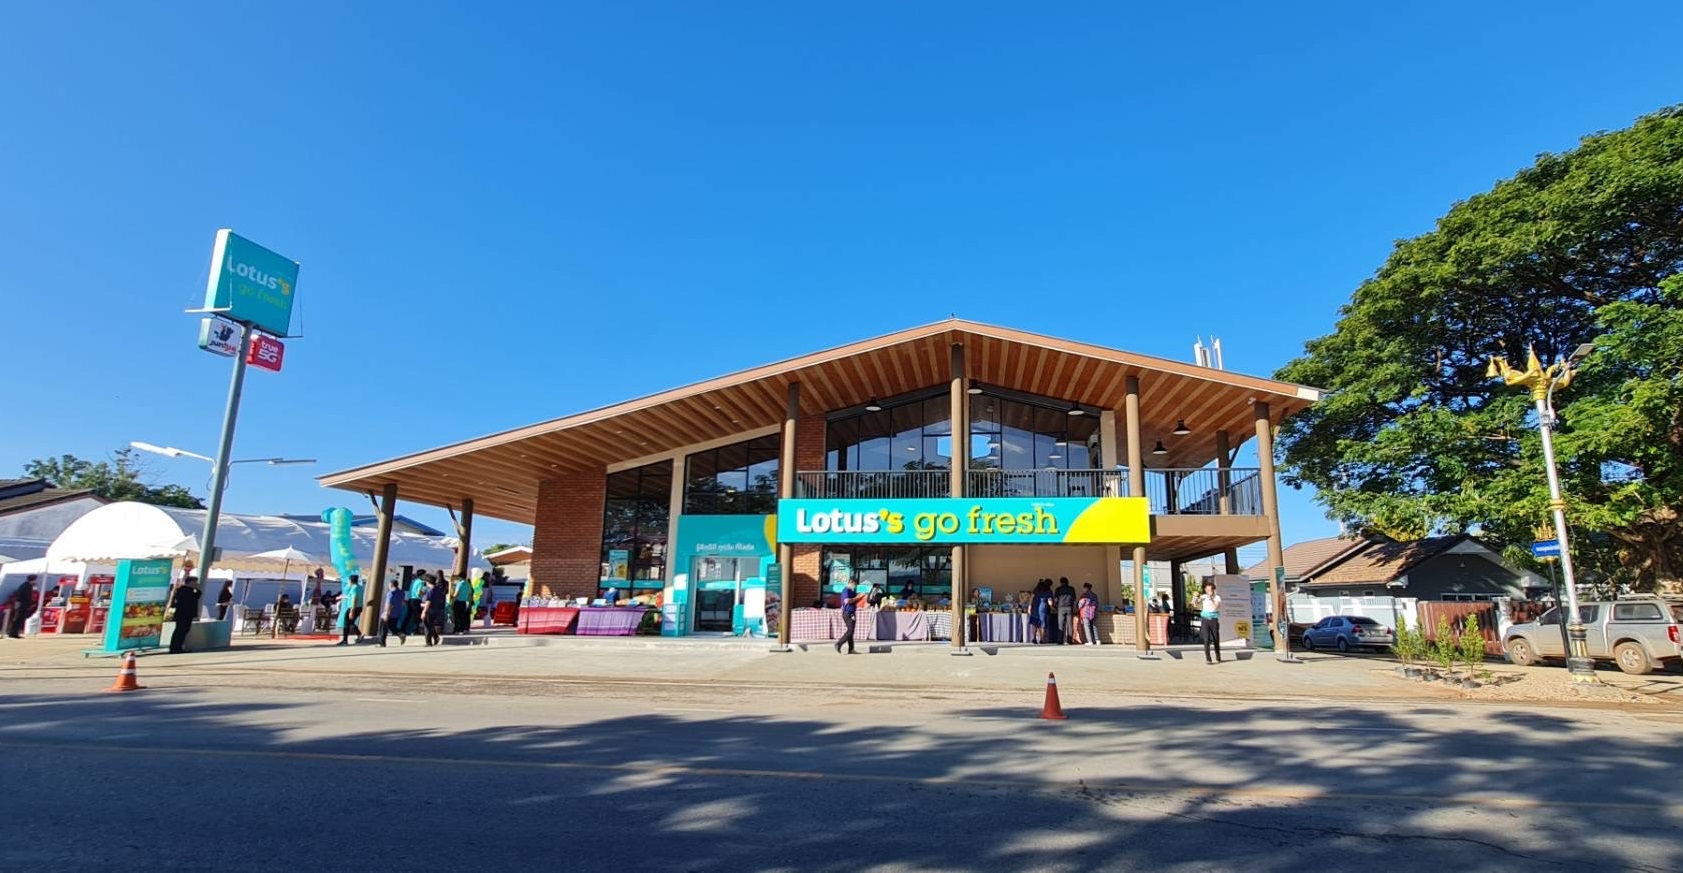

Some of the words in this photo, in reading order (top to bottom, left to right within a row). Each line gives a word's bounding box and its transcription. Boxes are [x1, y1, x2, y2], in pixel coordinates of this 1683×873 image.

[226, 255, 290, 295] Lotus's
[258, 349, 279, 363] 5G
[261, 341, 279, 353] true
[796, 507, 905, 533] Lotus's
[914, 511, 961, 540] go
[967, 505, 1060, 534] fresh
